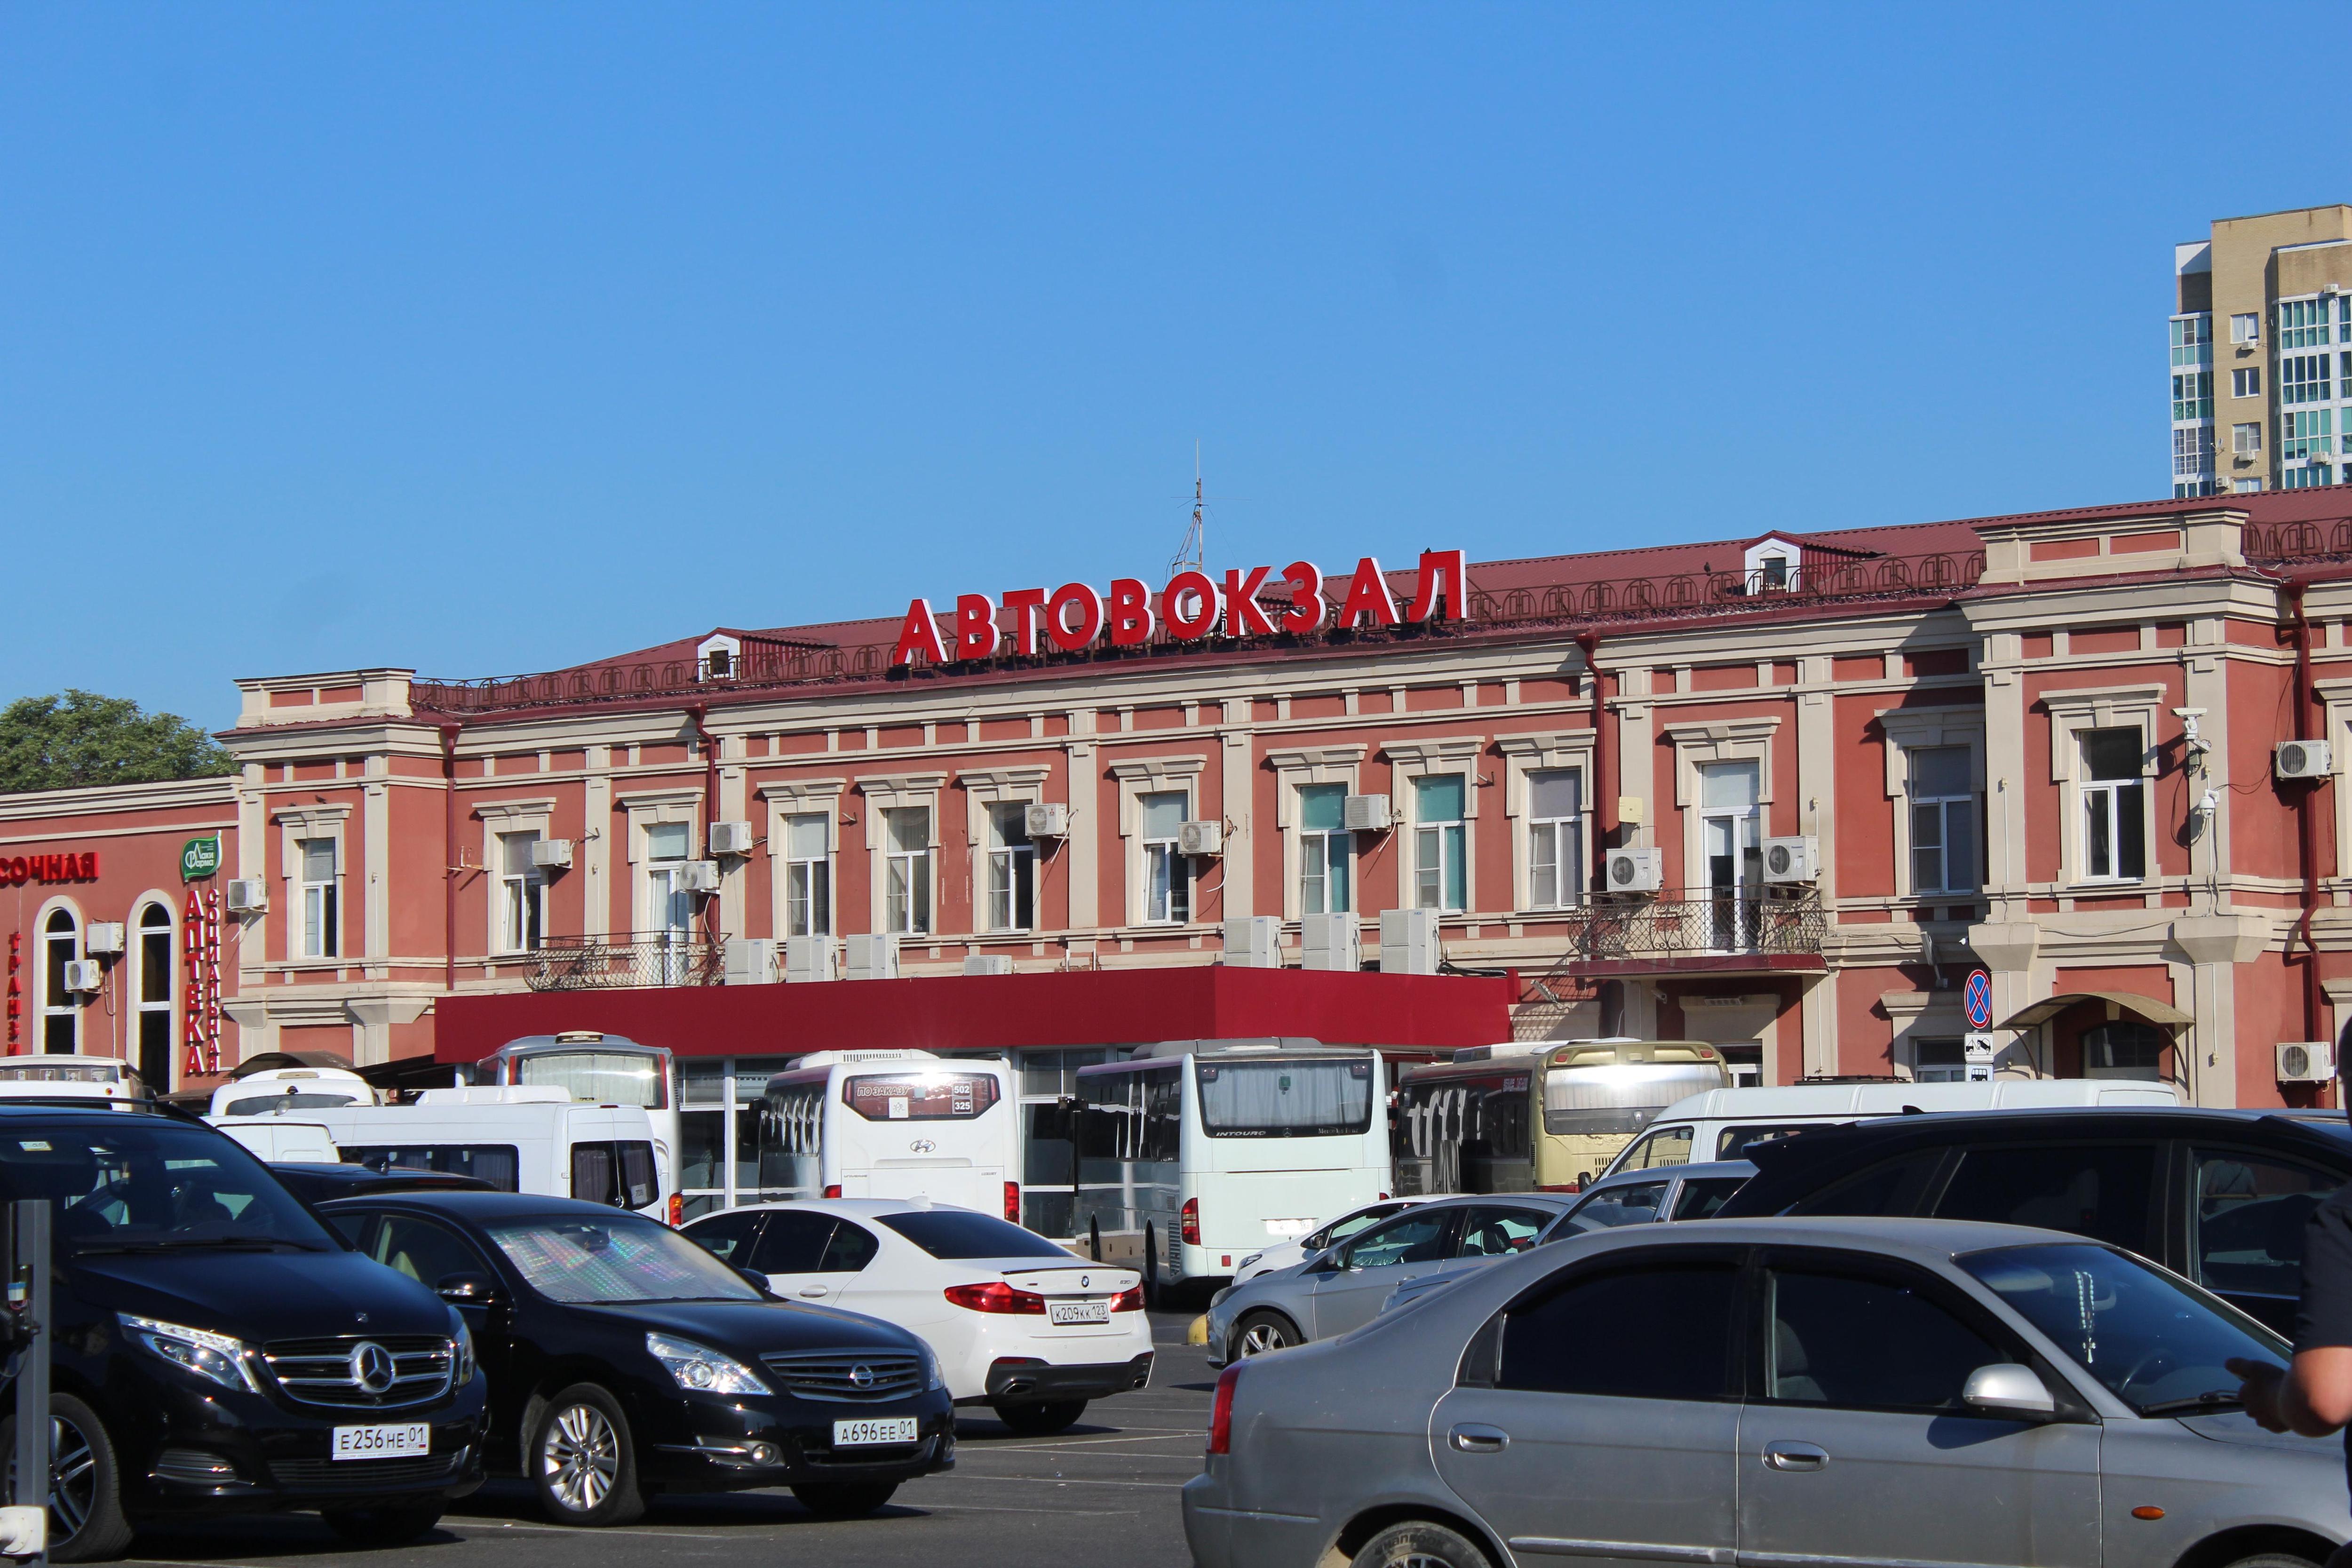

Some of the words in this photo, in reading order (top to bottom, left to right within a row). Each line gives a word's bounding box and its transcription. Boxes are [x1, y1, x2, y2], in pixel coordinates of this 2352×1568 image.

[893, 549, 1467, 665] АВТОВОКЗАЛ
[185, 851, 214, 869] Фарма
[183, 890, 205, 1073] АПТЕКА
[206, 888, 221, 1073] СОЦИАЛЬНАЯ
[858, 1087, 872, 1097] ПО
[873, 1086, 909, 1096] ЗАКАЗУ
[954, 1085, 970, 1094] 502
[954, 1102, 970, 1110] 325
